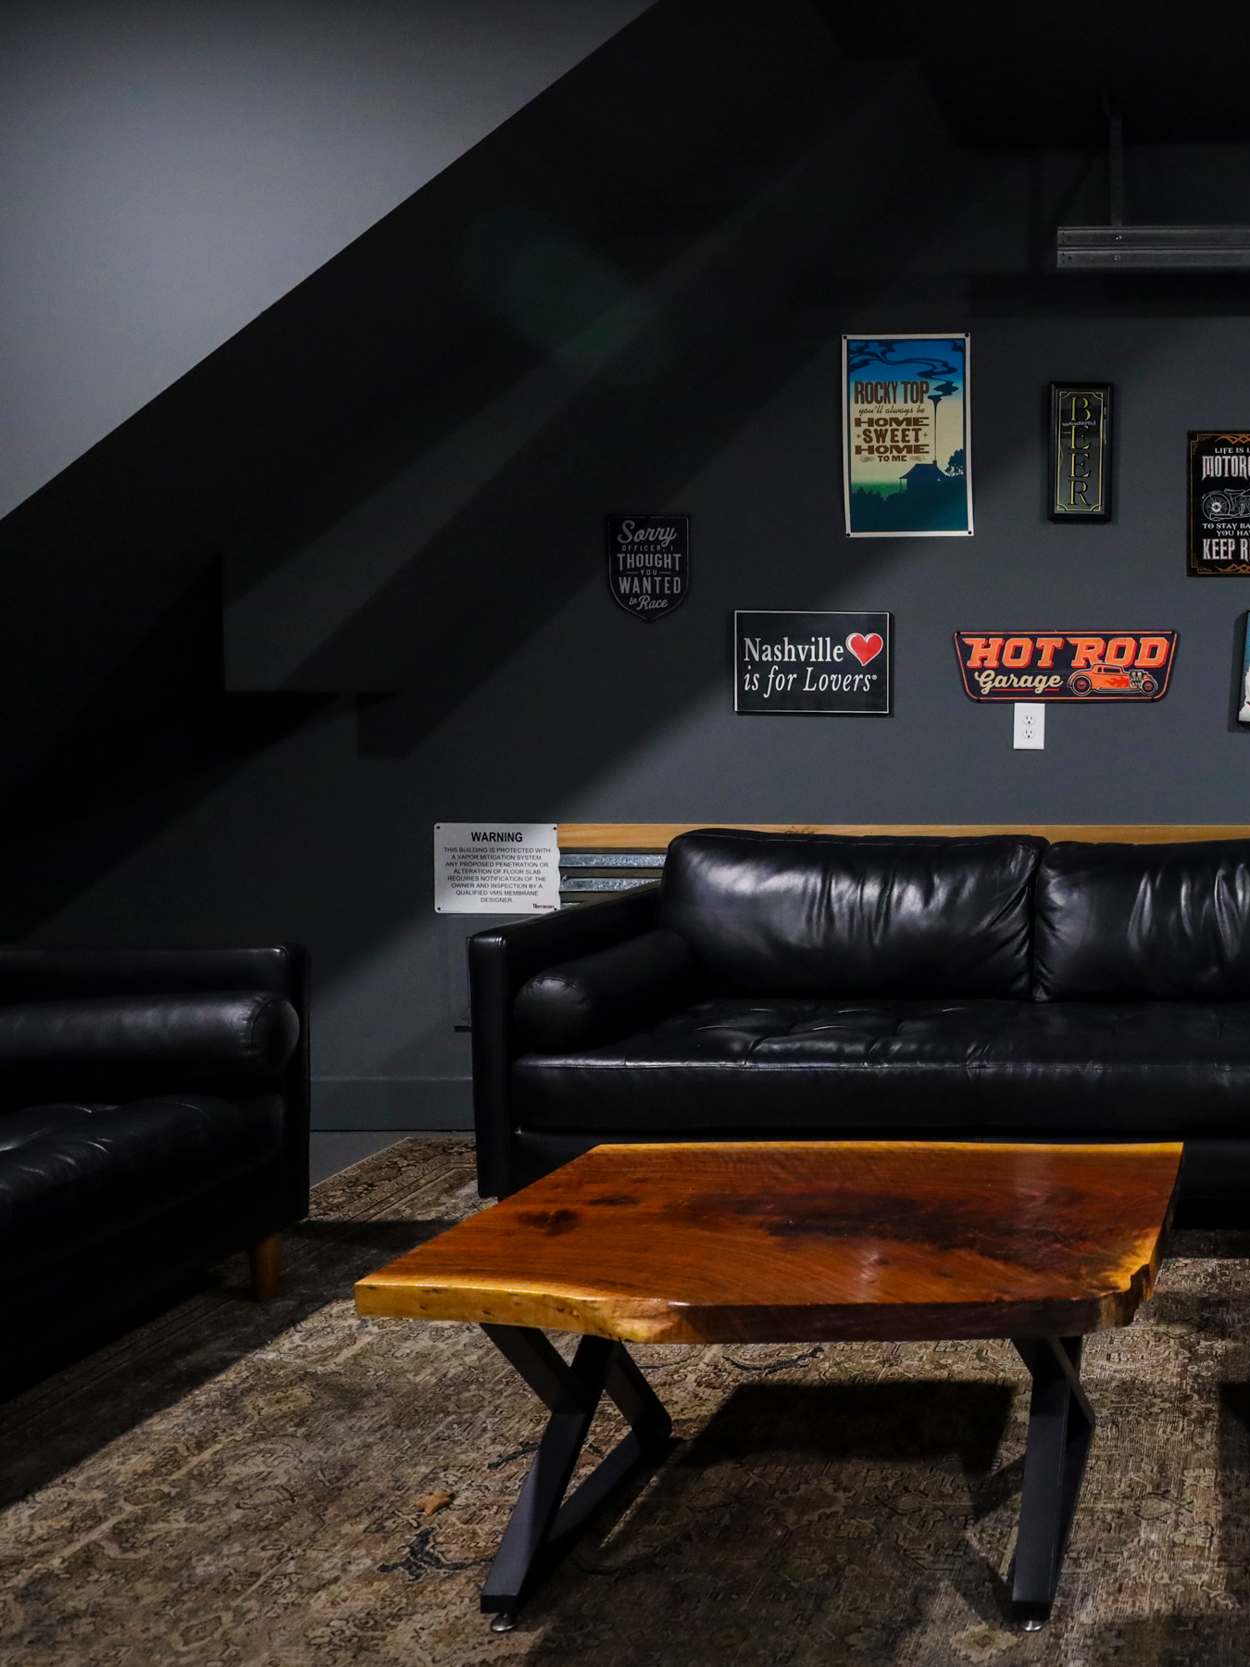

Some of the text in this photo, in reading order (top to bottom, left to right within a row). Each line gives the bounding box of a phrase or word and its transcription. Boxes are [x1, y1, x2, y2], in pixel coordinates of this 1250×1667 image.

[854, 380, 929, 404] ROCKY TOP
[858, 405, 883, 416] you'll
[885, 405, 913, 416] always
[854, 417, 930, 427] HOME
[862, 428, 922, 443] SWEET
[855, 444, 929, 455] HOME
[617, 520, 677, 548] Sorry
[1203, 538, 1235, 560] KEEP
[617, 553, 681, 571] THOUGHT
[619, 576, 681, 594] WANTED
[636, 595, 668, 610] Race
[744, 637, 844, 662] Nashville
[962, 636, 1170, 669] HOT ROD
[744, 666, 760, 691] is
[763, 665, 797, 698] for
[974, 670, 1063, 695] Garage
[471, 832, 523, 842] WARNING
